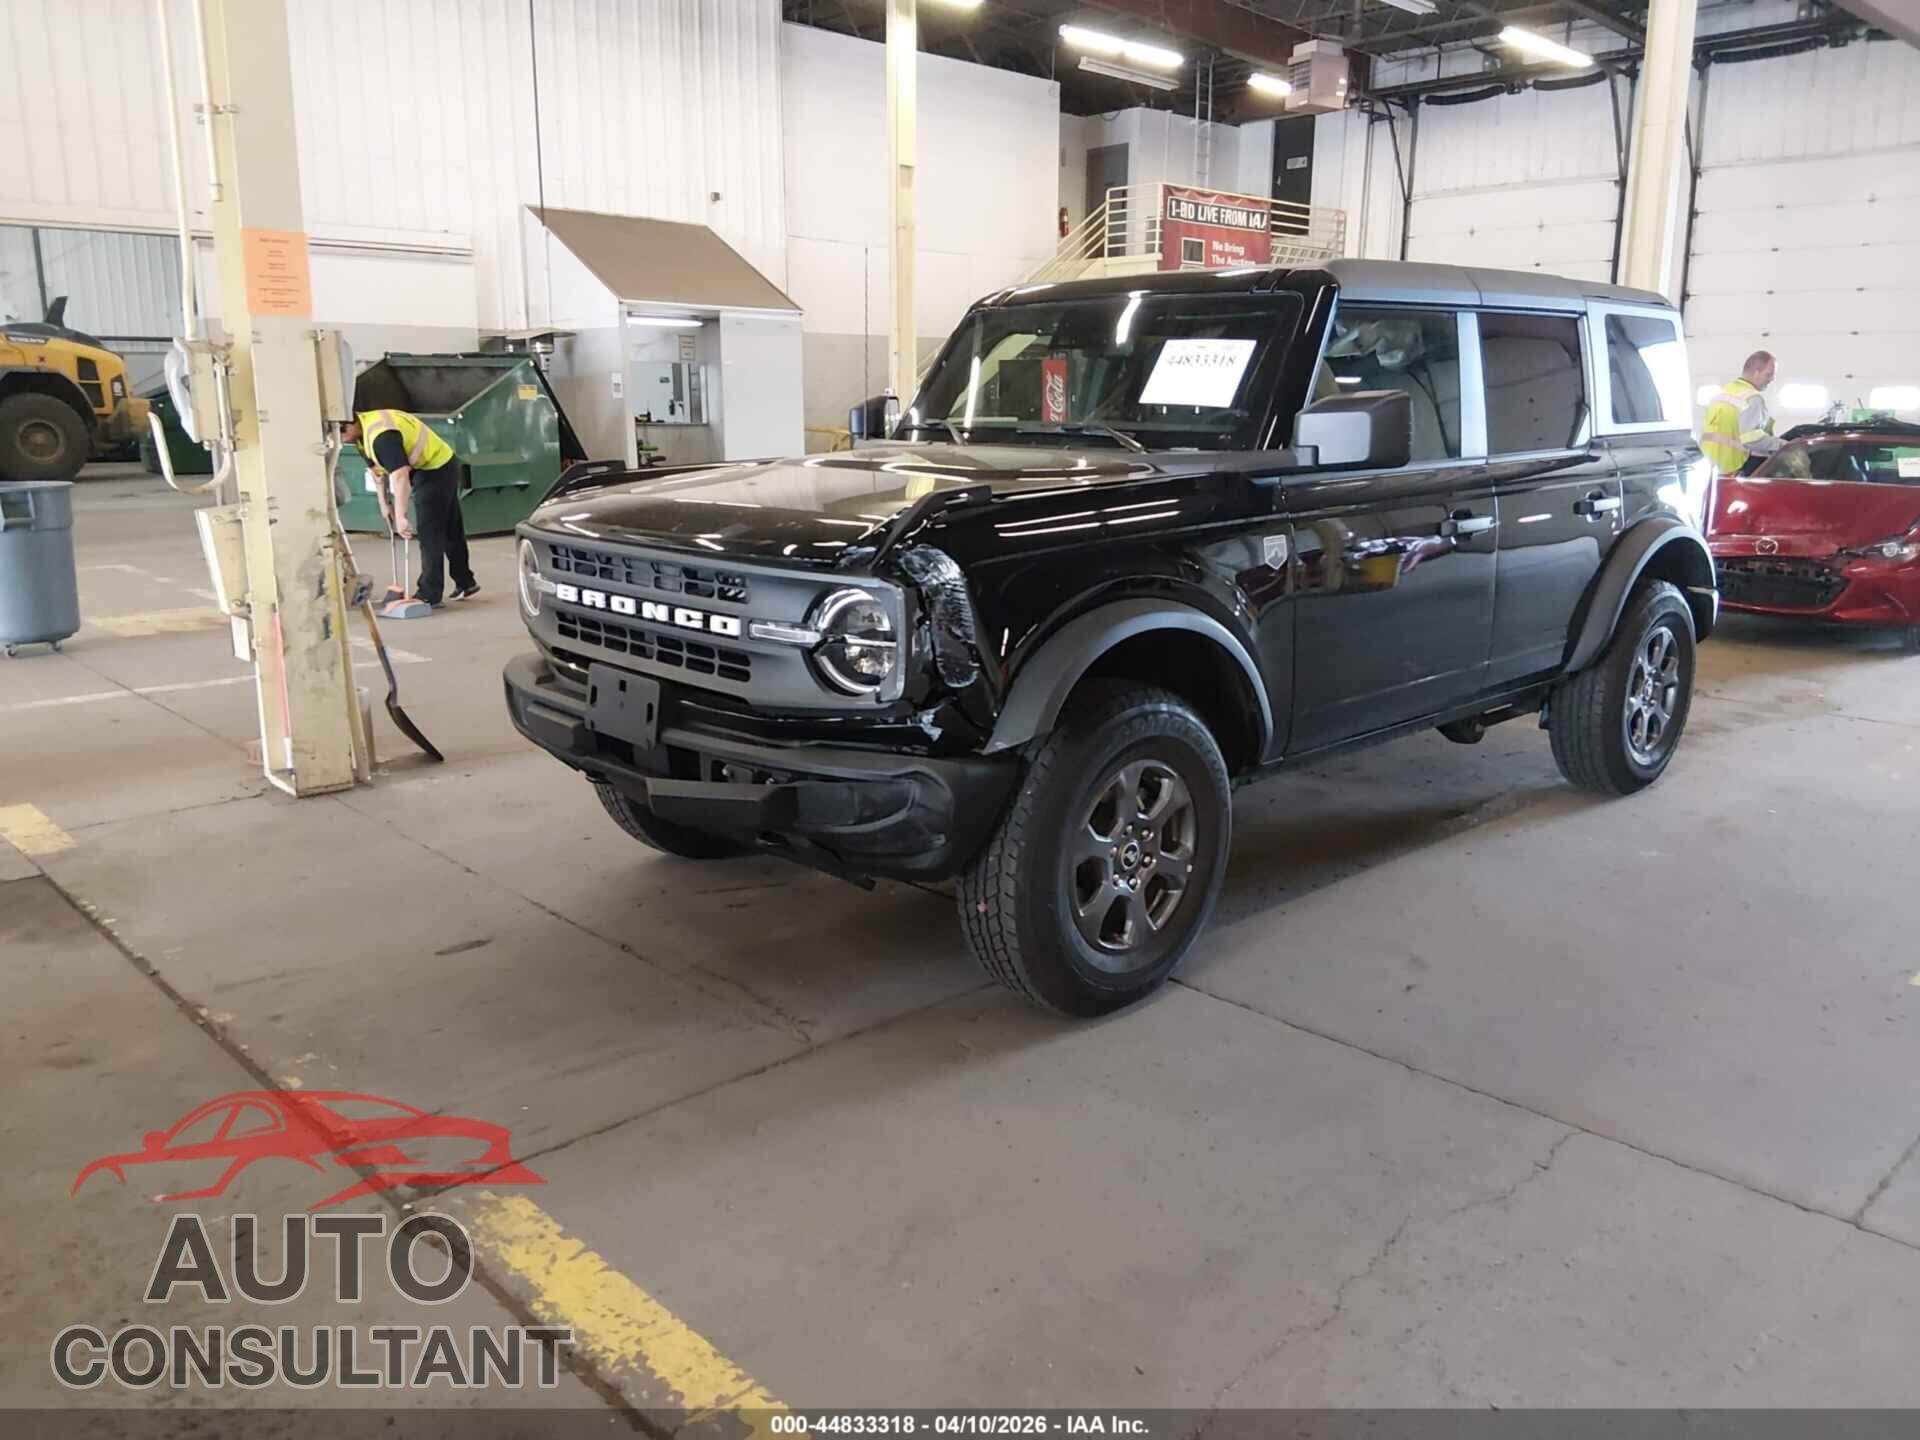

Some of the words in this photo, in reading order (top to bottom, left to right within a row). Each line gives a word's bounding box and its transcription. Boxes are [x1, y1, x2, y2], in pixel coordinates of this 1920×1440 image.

[1198, 205, 1218, 223] LIVE
[1220, 208, 1247, 227] FROM
[556, 582, 741, 637] BRONCO
